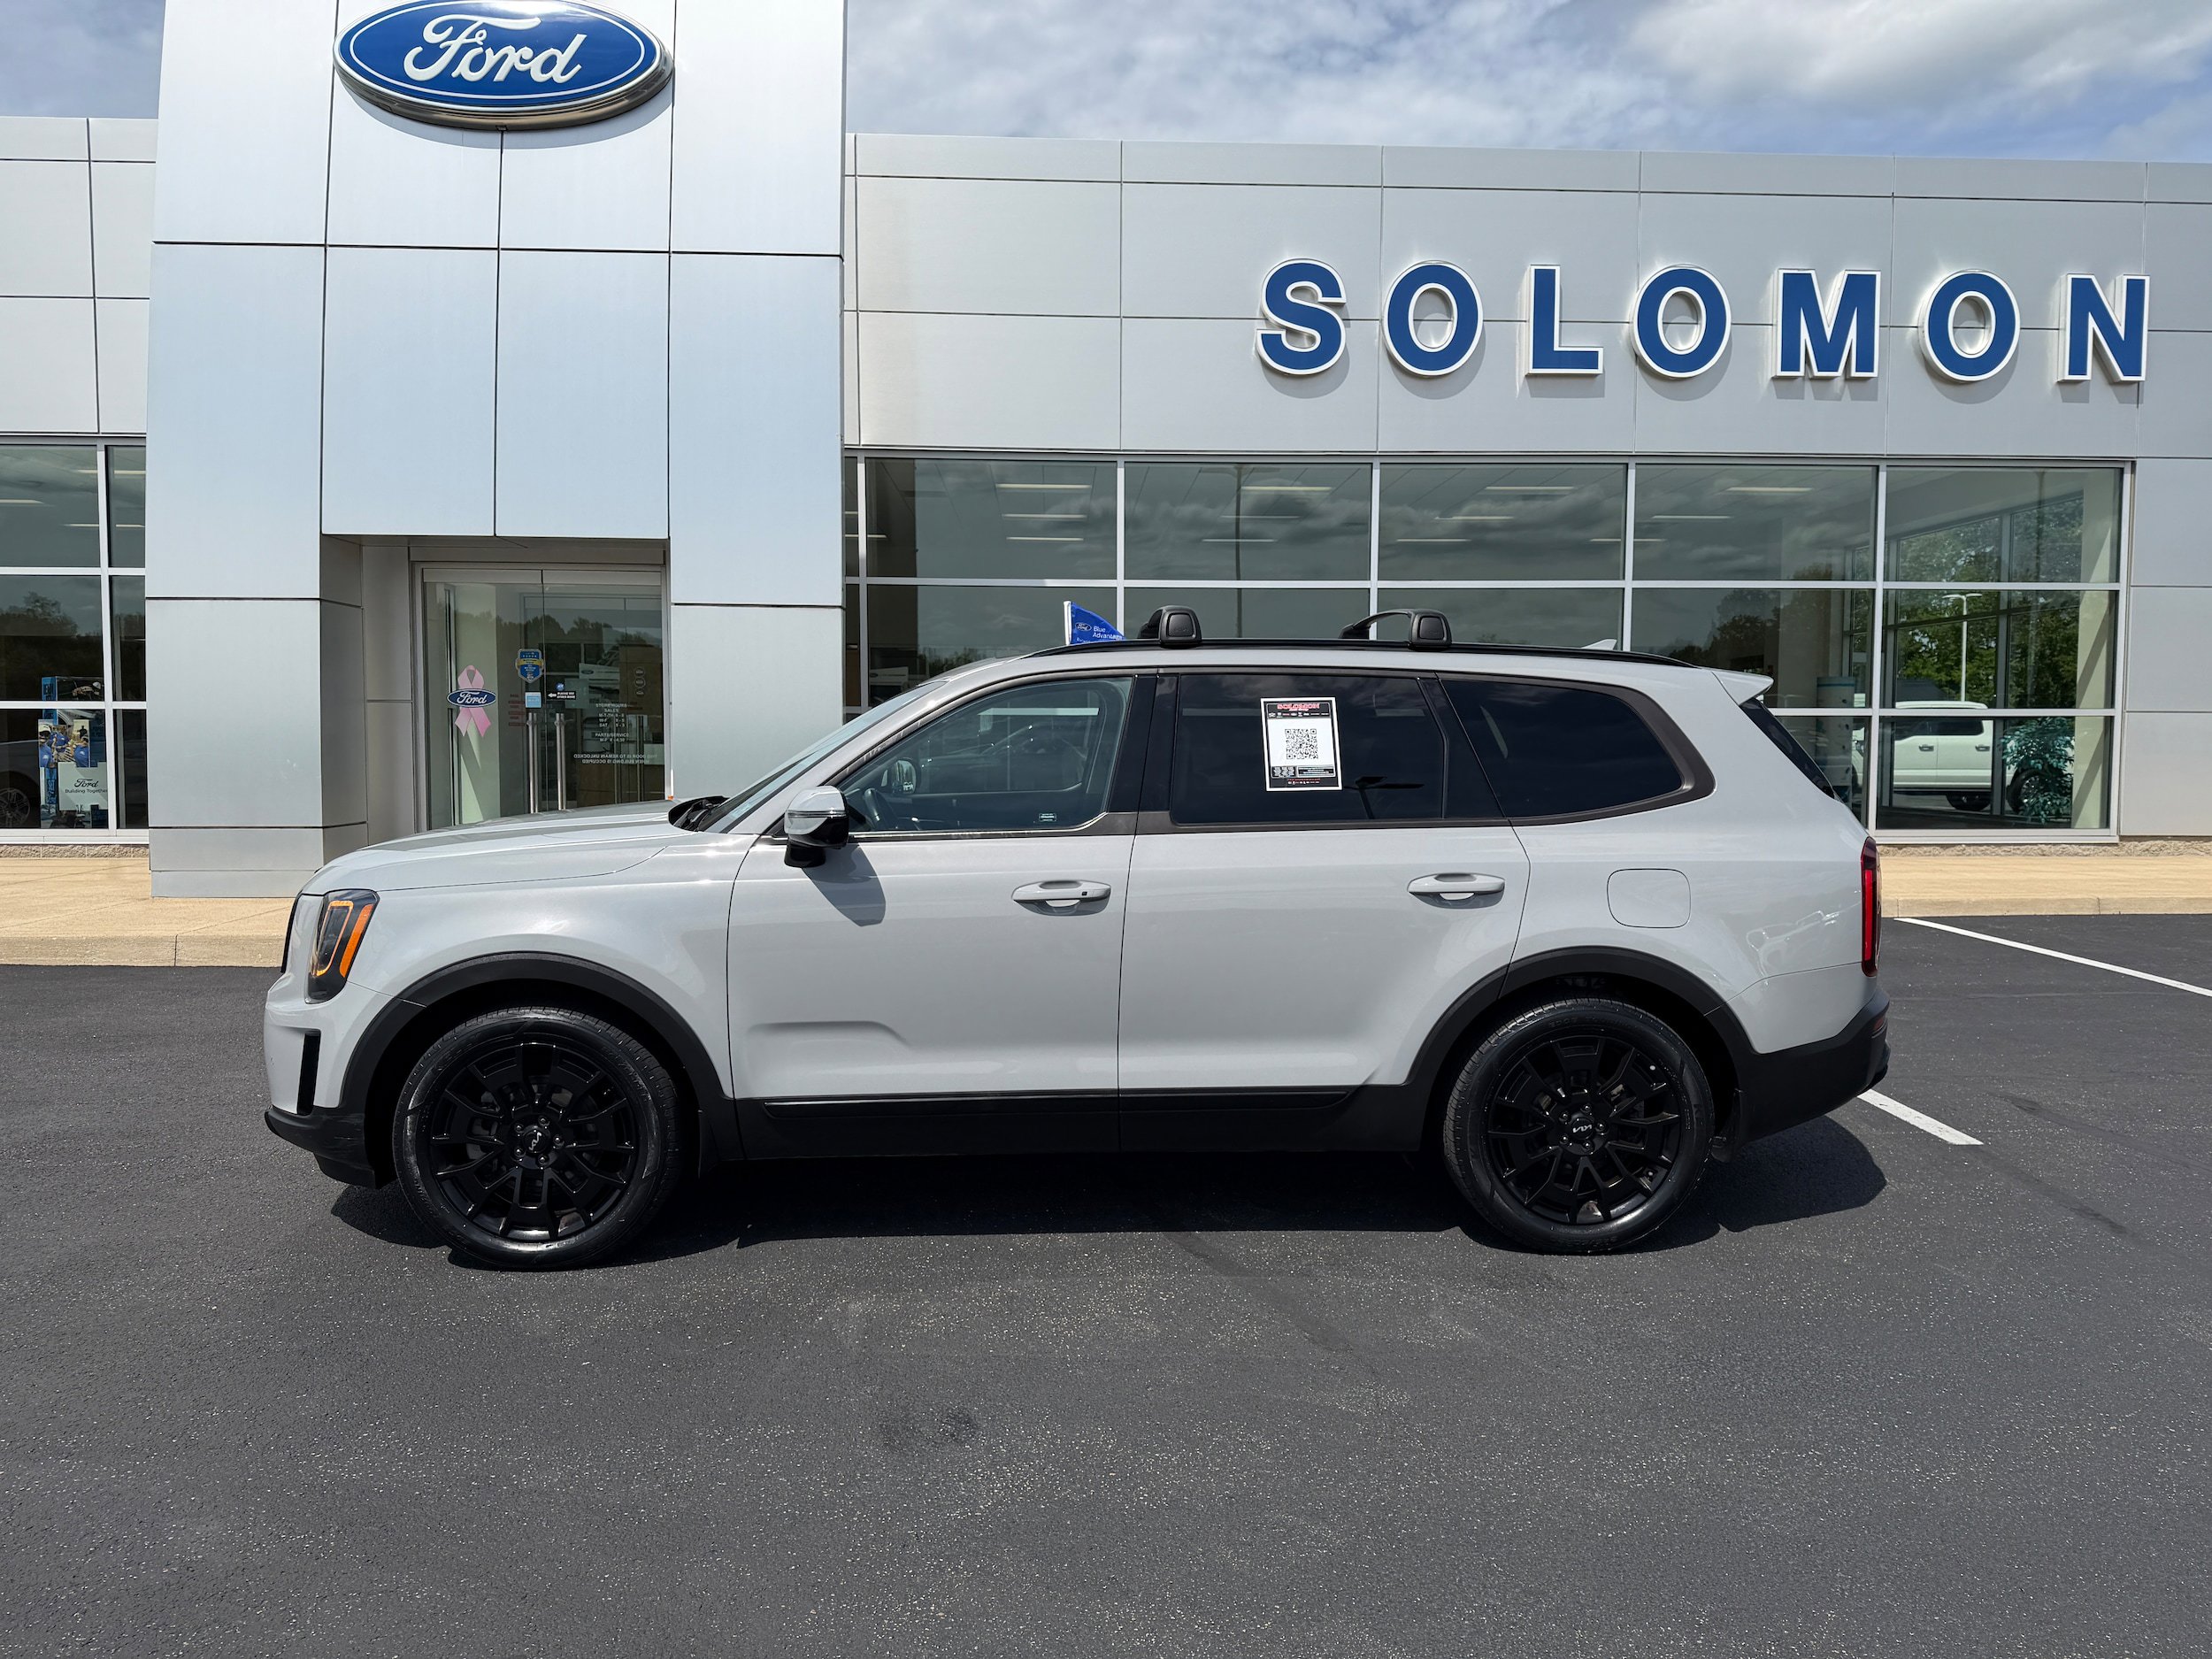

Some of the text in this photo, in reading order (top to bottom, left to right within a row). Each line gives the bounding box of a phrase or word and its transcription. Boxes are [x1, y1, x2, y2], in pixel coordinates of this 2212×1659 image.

[403, 14, 588, 83] Ford
[1256, 258, 2150, 383] SOLOMON
[457, 691, 488, 704] Ford
[74, 779, 99, 787] Ford
